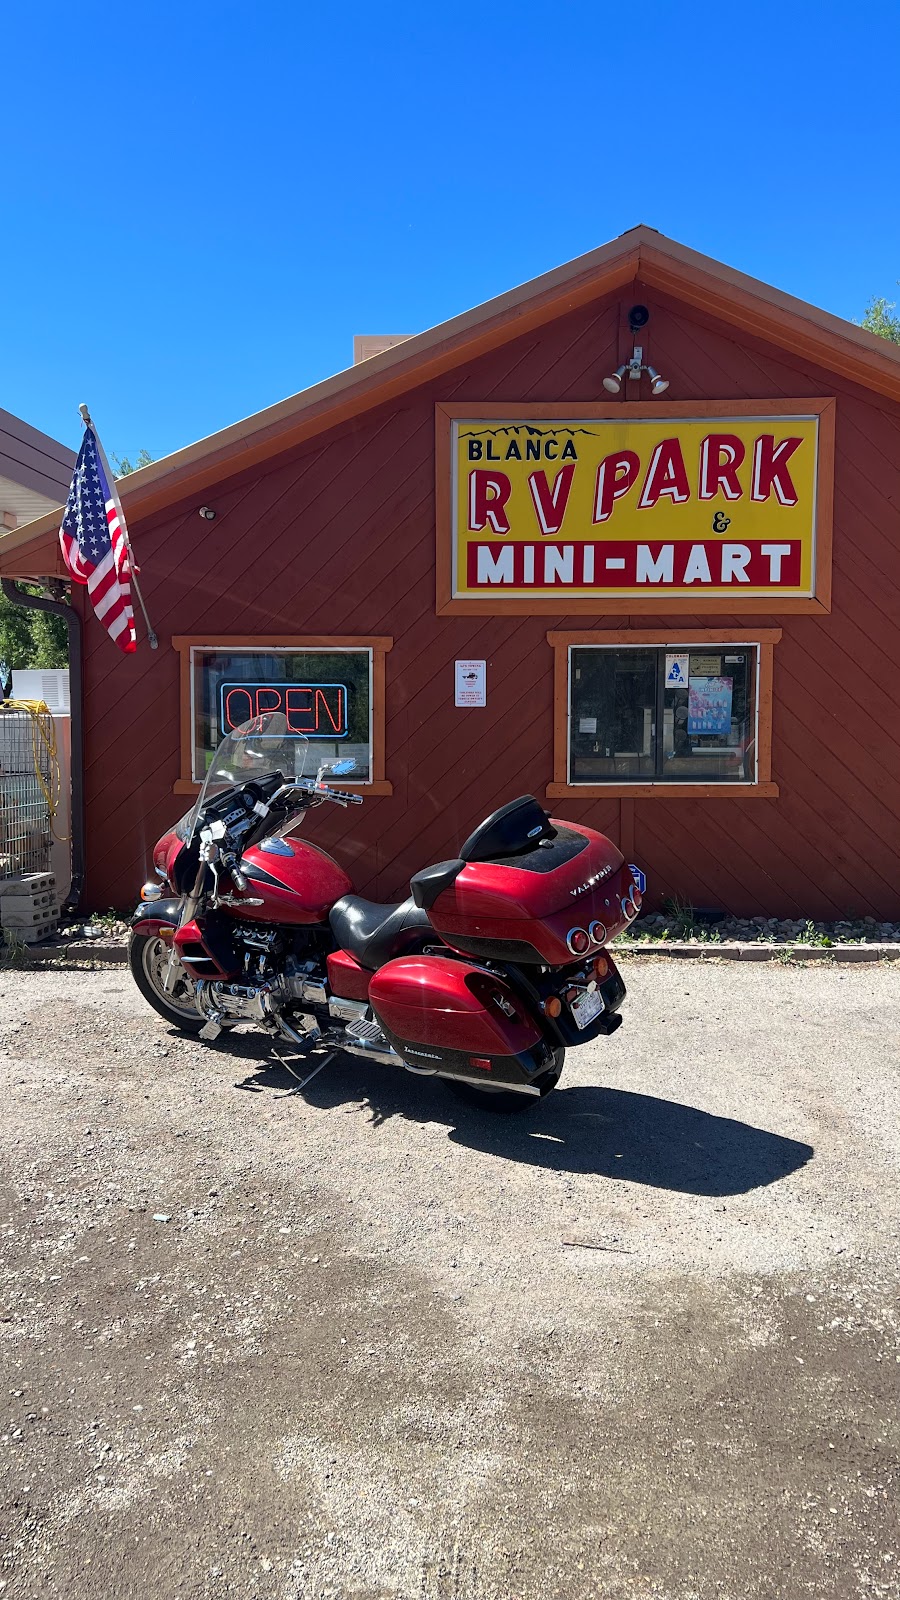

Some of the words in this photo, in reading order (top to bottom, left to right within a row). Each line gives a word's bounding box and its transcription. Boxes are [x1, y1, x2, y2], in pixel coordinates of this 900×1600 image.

[468, 439, 578, 461] BLANCA
[467, 464, 576, 536] RV
[592, 433, 804, 525] PARK
[713, 511, 731, 534] &
[476, 543, 791, 585] MINI-MART
[226, 688, 342, 734] OPEN
